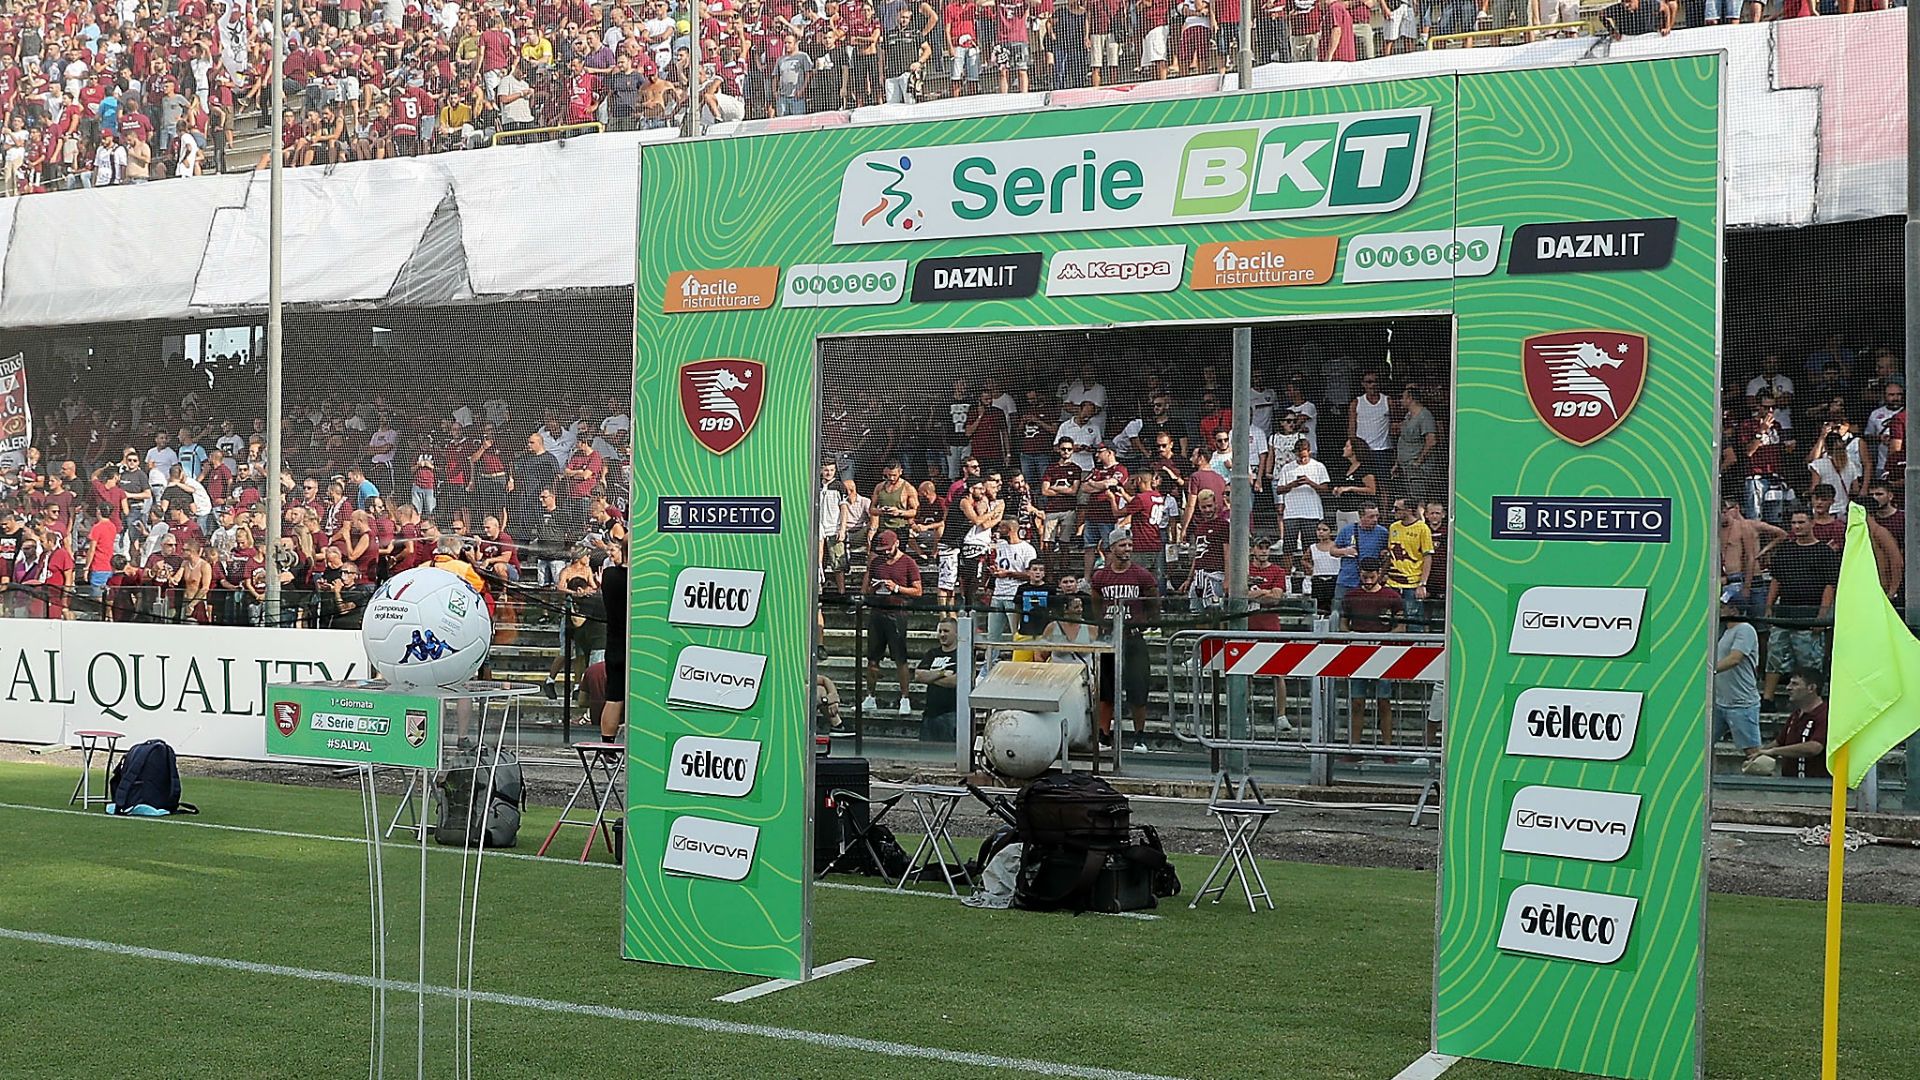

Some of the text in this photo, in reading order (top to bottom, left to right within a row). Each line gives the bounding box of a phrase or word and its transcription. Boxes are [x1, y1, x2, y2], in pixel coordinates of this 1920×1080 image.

[951, 130, 1413, 220] Serie BKT
[1357, 242, 1486, 267] UNIBET
[1536, 232, 1645, 260] DAZN.IT
[933, 265, 1018, 290] DAZN.IT
[1087, 261, 1171, 279] Kappa
[1215, 268, 1315, 285] ristrutturare
[793, 272, 895, 294] UNIBET
[682, 293, 761, 309] ristrutturare
[1552, 401, 1602, 418] 1919
[699, 417, 734, 431] 1919
[689, 507, 776, 524] RISPETTO
[1537, 509, 1663, 531] RISPETTO
[1541, 615, 1633, 630] GIVOVA
[0, 648, 75, 704] AL
[693, 669, 756, 689] GIVOVA
[340, 698, 374, 709] Giornata
[327, 715, 388, 733] Serie BKT
[326, 738, 372, 752] #SALPAL
[1536, 814, 1627, 836] GIVOVA
[686, 840, 749, 860] GIVOVA
